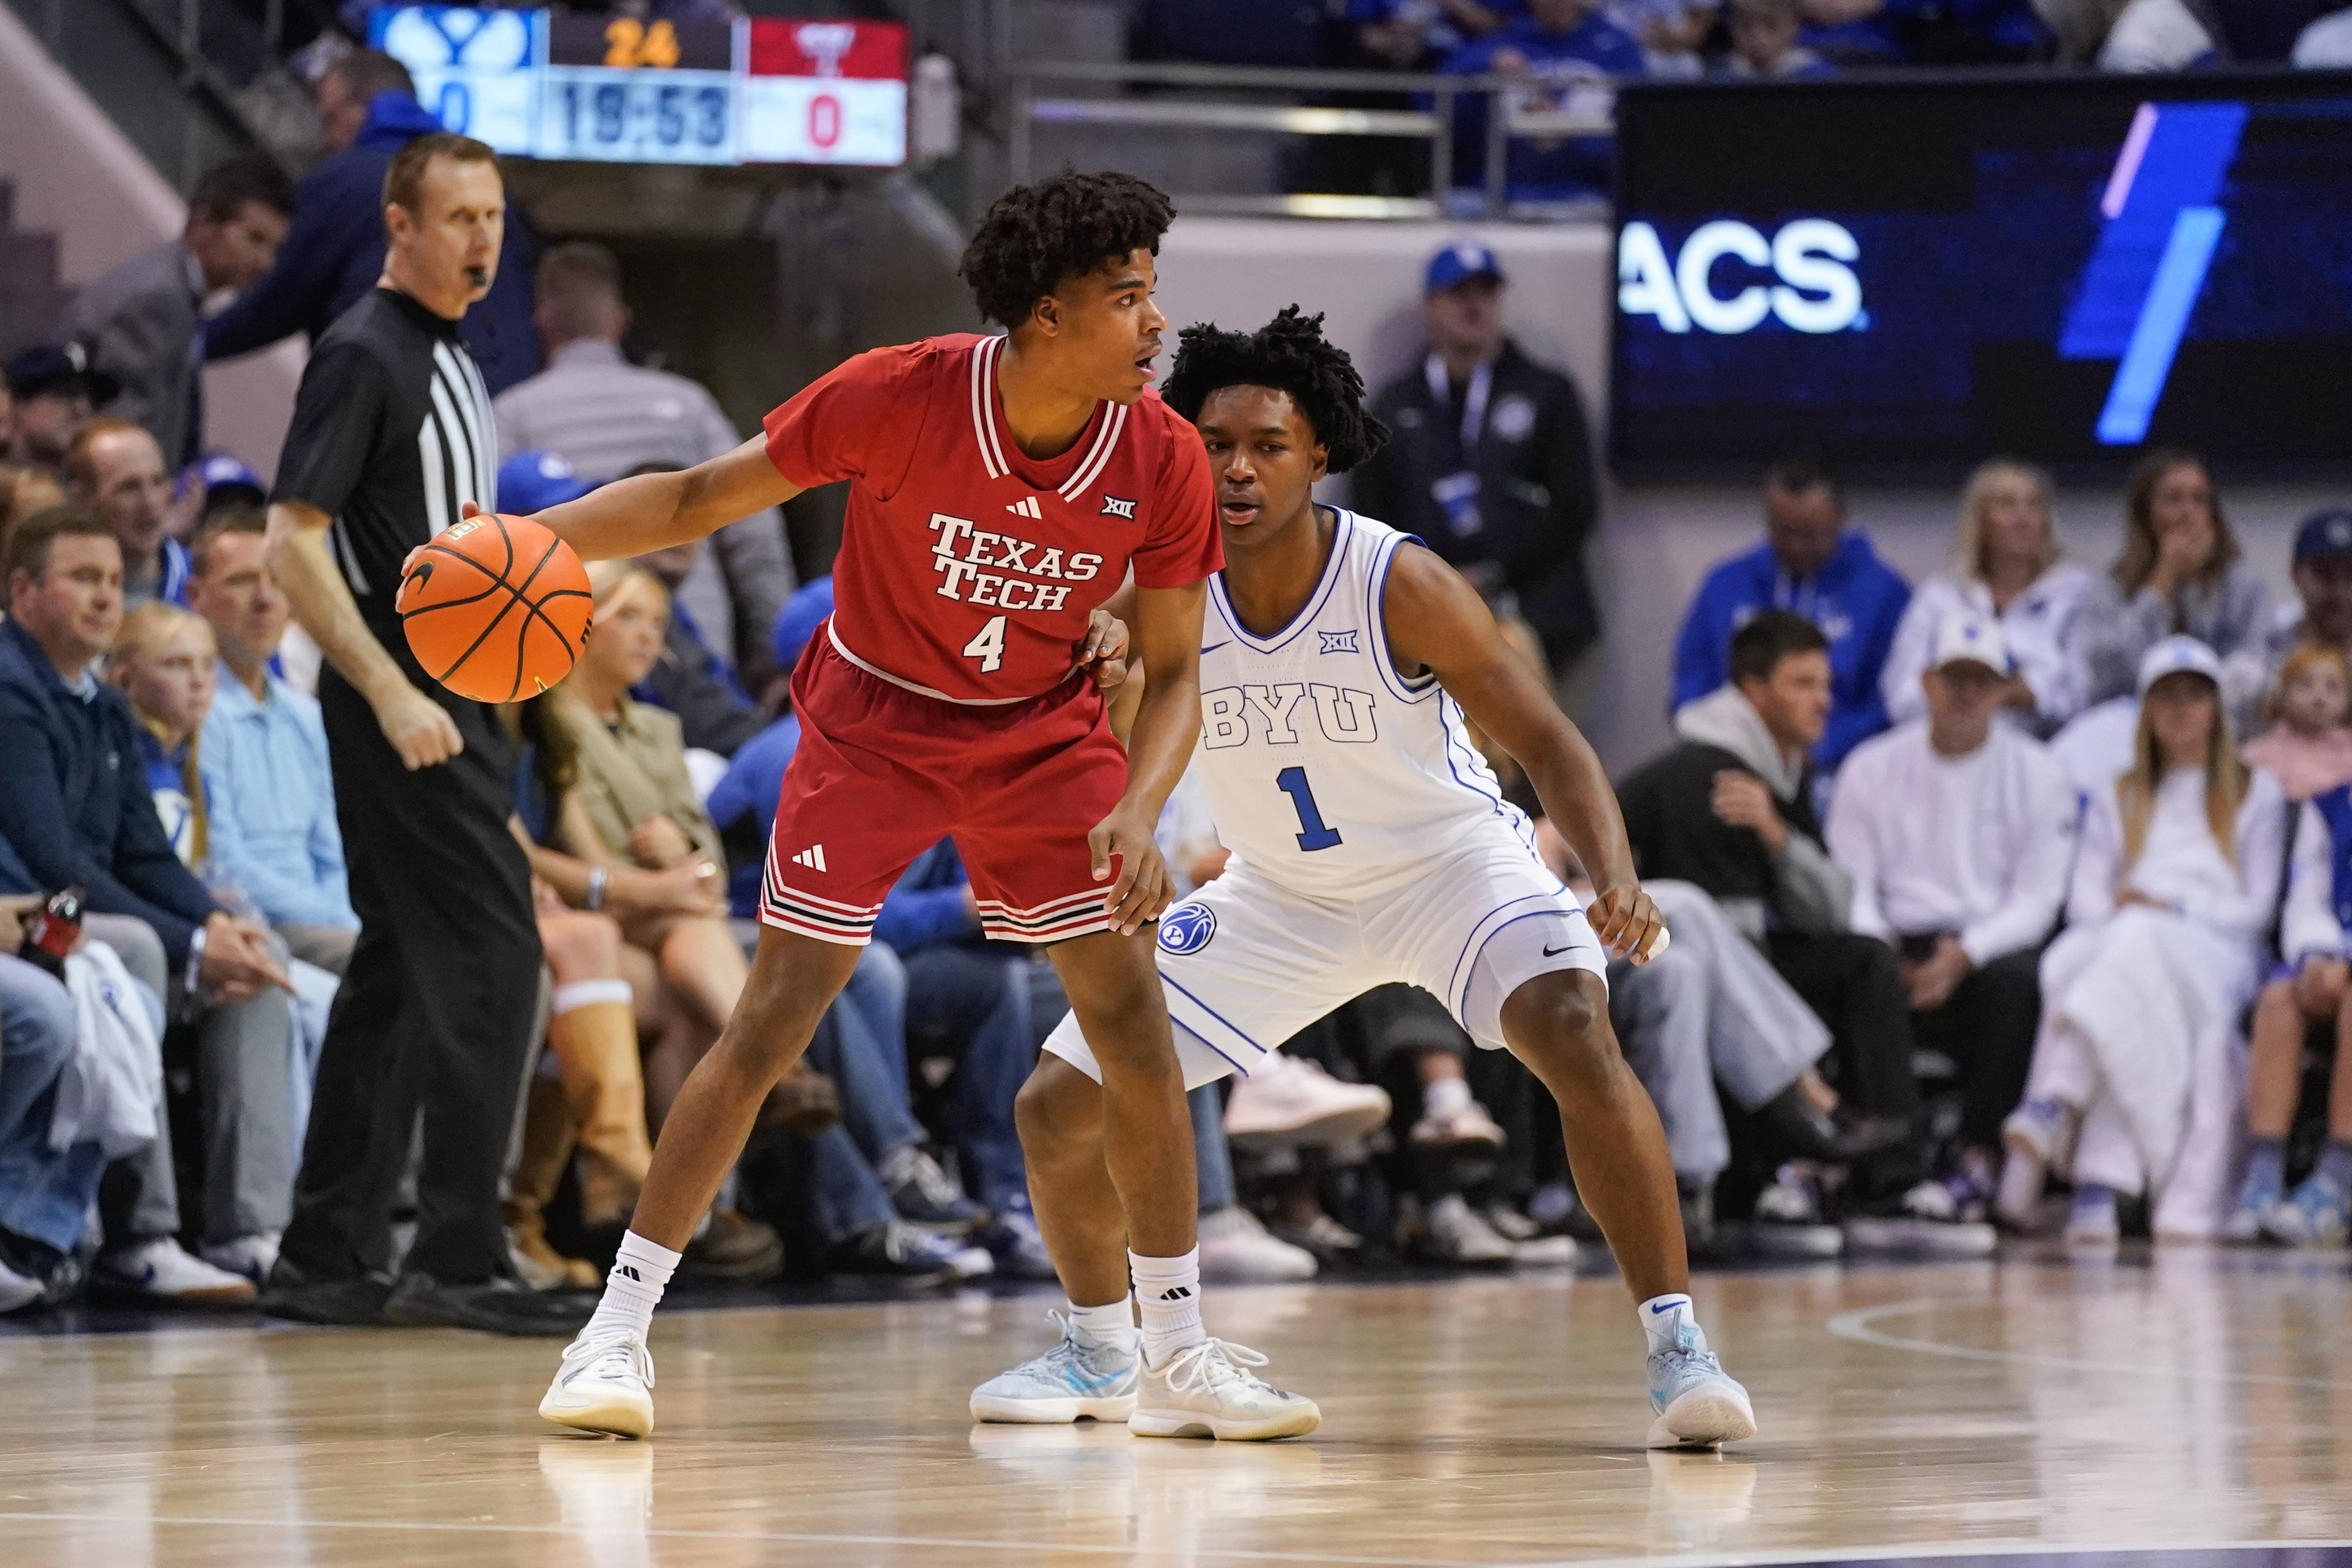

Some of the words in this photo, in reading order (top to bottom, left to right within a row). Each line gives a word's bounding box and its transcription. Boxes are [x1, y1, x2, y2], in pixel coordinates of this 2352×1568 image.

[603, 17, 681, 68] 24
[810, 95, 839, 148] 0
[928, 513, 1104, 581] TEXAS
[934, 554, 1073, 611] TECH
[962, 615, 1007, 673] 4
[1200, 682, 1377, 750] BYU
[1276, 766, 1343, 851] 1
